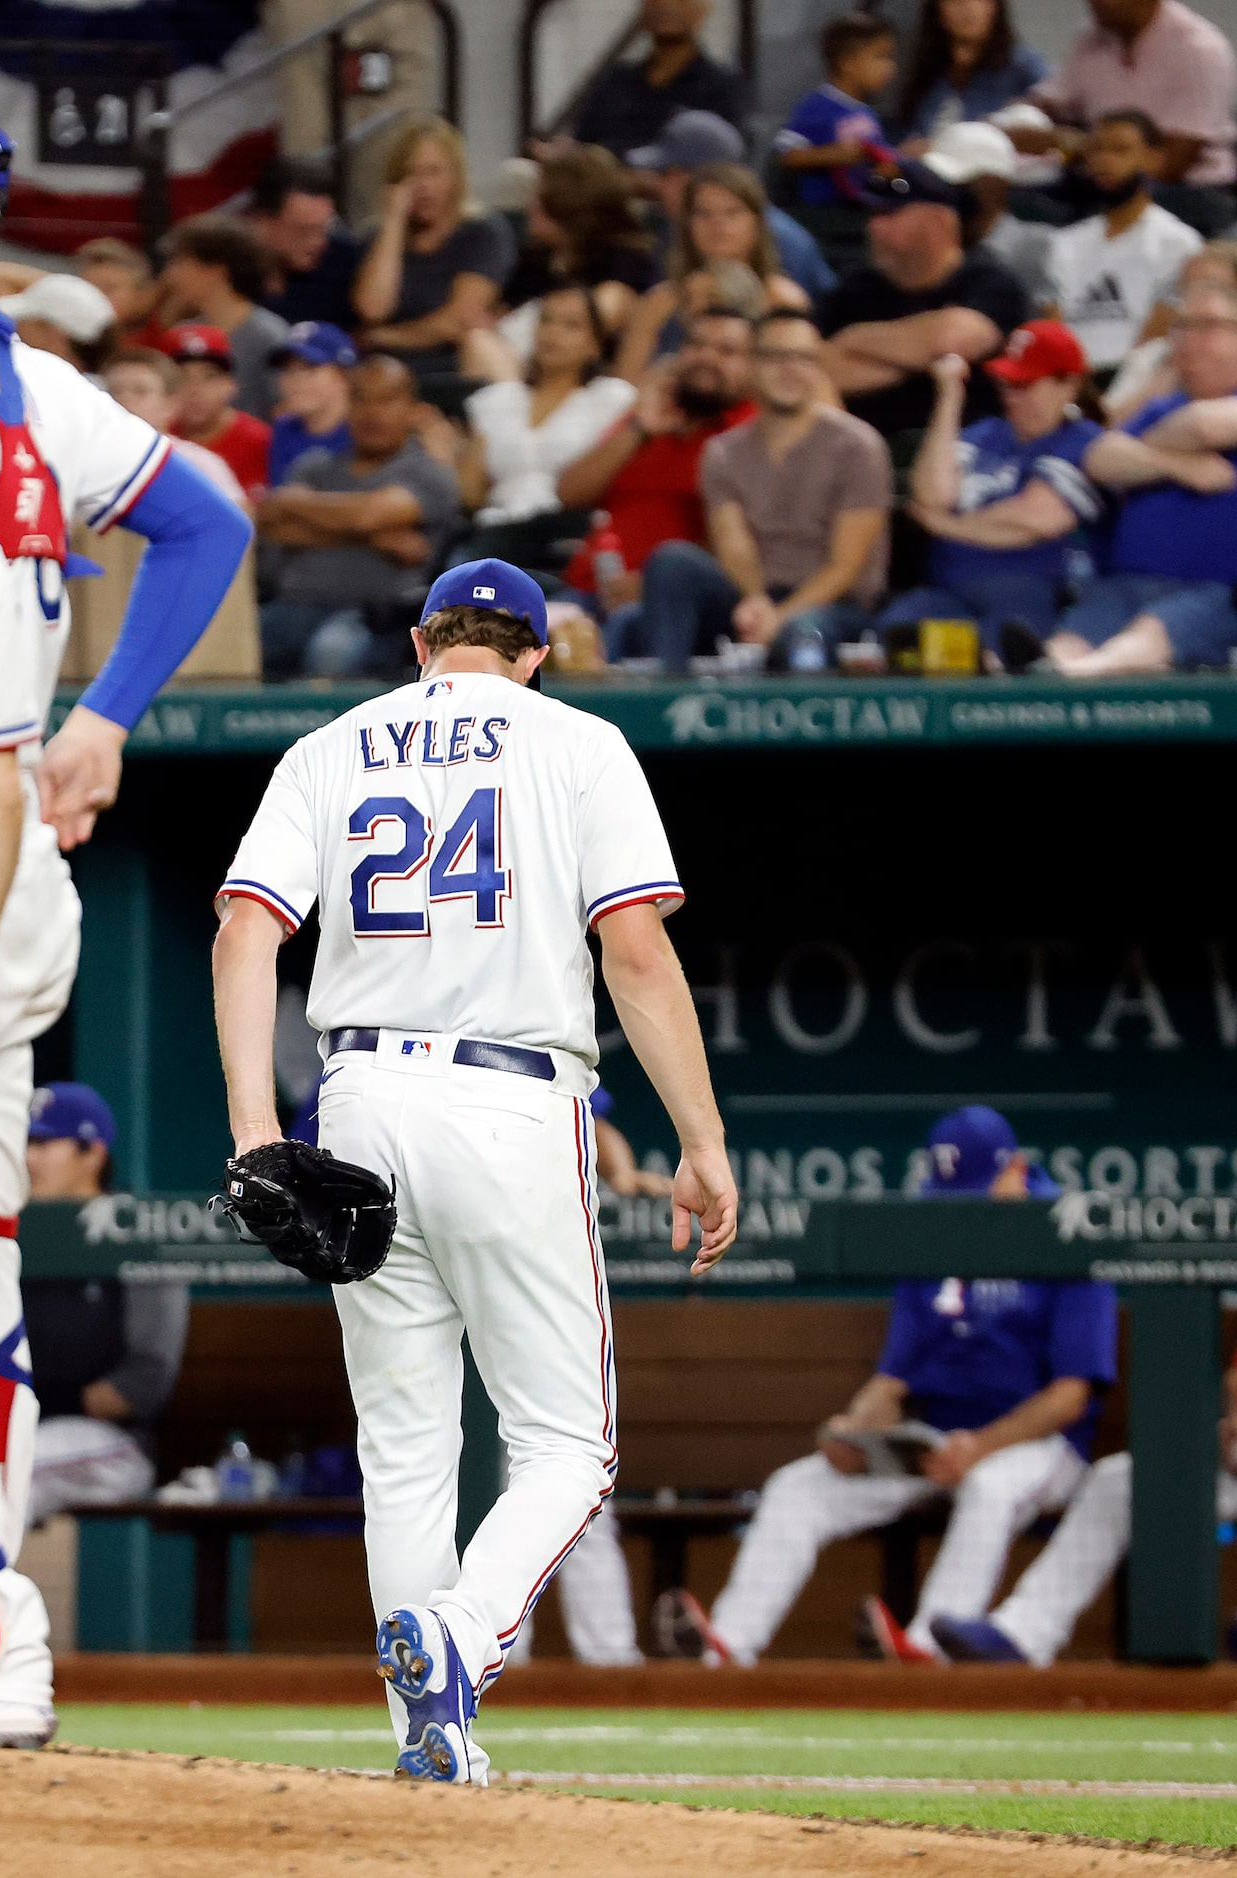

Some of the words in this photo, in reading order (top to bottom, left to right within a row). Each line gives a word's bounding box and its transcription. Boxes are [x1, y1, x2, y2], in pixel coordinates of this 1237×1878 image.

[700, 694, 928, 740] CHOCTAW
[359, 717, 511, 772] LYLES
[347, 787, 512, 938] 24
[110, 1193, 234, 1243] CHOC
[1079, 1191, 1237, 1241] CHOCT
